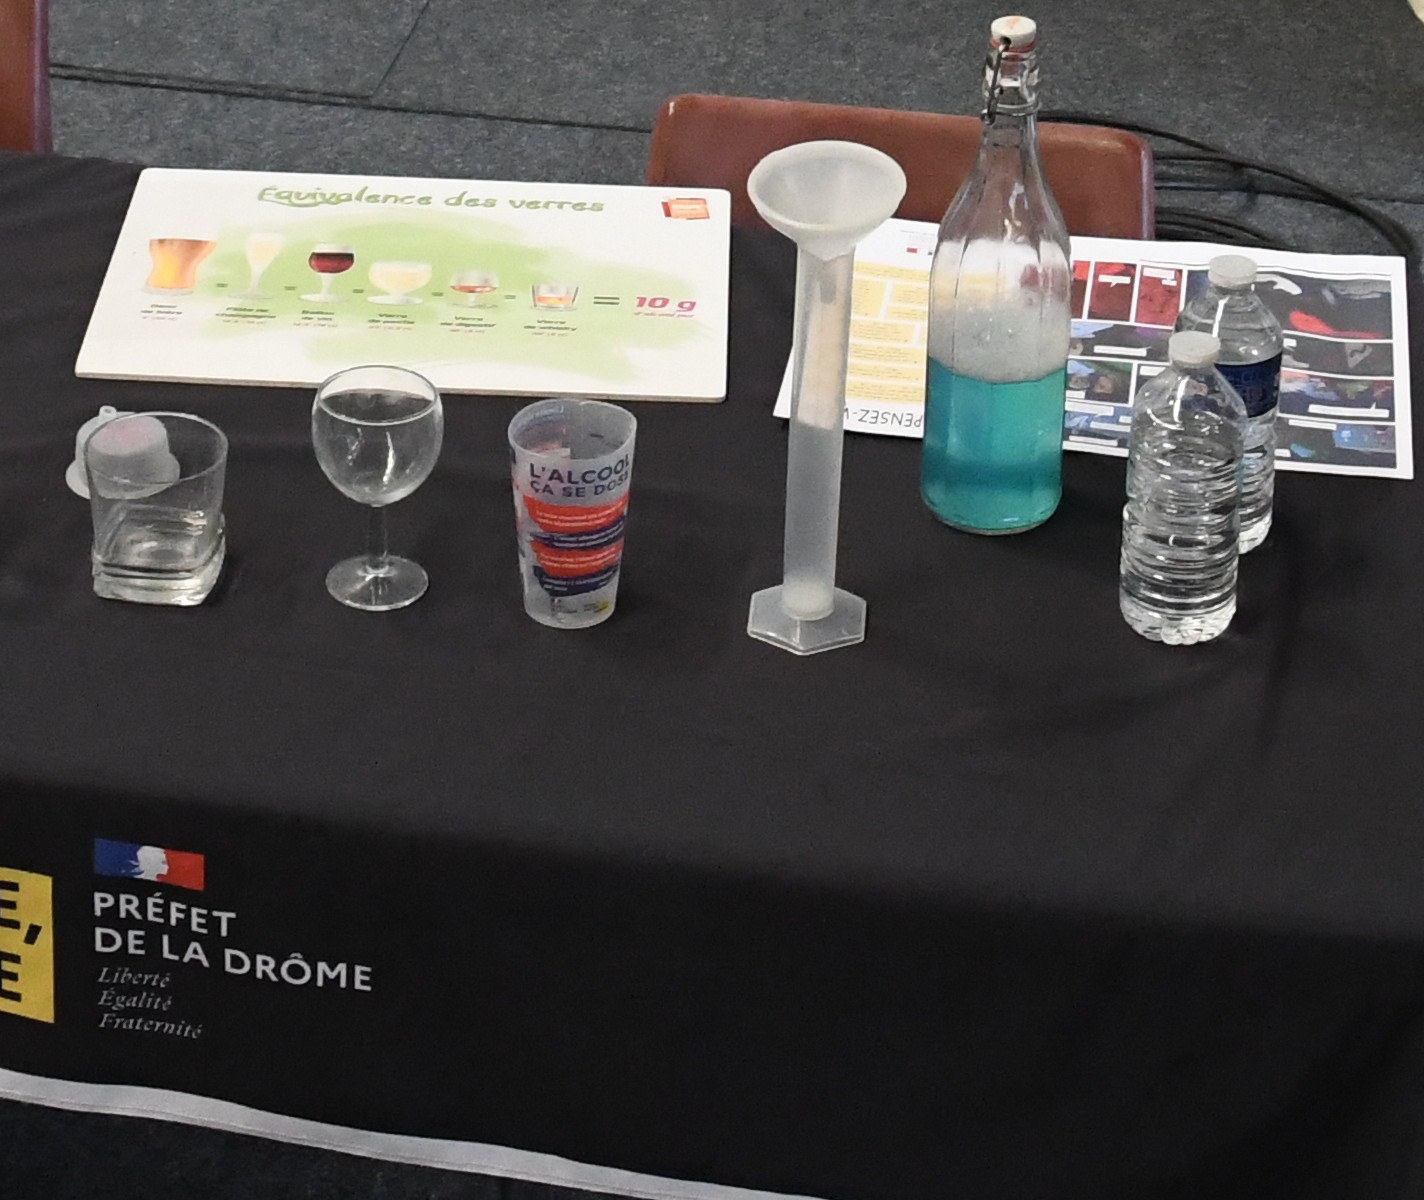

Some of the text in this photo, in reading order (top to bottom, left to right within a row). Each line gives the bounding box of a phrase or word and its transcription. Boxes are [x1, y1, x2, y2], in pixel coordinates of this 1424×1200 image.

[443, 190, 497, 209] des
[509, 199, 606, 213] verres
[636, 296, 697, 313] 10 g
[530, 479, 554, 497] ÇA
[561, 486, 586, 498] SE
[93, 891, 237, 937] PRÉFET
[94, 926, 373, 992] DE LA DRÔME
[97, 966, 172, 989] Liberté
[97, 987, 173, 1012] Égalité
[98, 1012, 204, 1040] Fraternité
